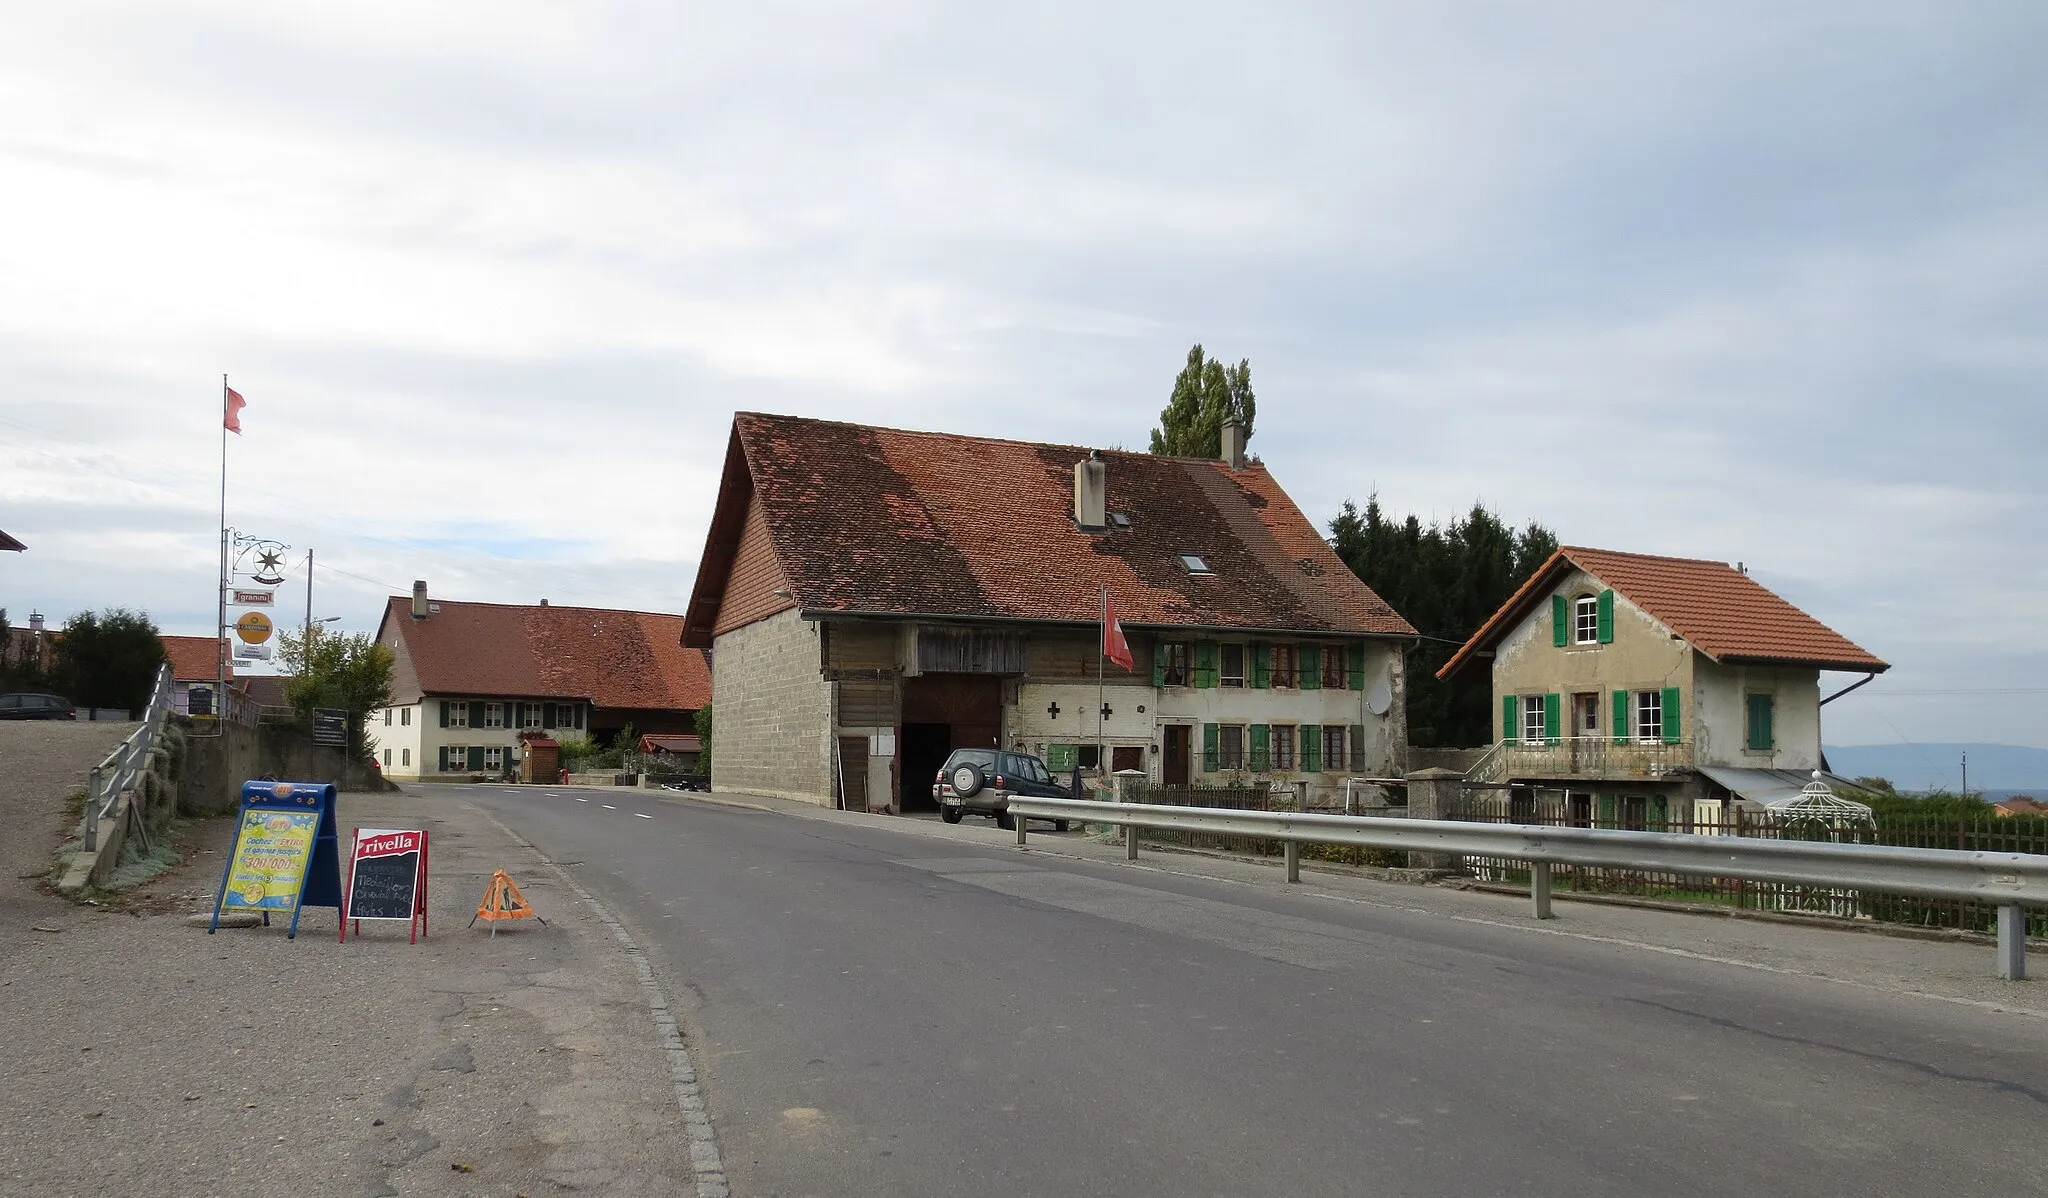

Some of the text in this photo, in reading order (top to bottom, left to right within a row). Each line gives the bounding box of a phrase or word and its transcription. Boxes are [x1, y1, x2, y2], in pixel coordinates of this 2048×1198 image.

[240, 594, 267, 603] granini
[365, 835, 413, 853] rivella
[251, 848, 276, 856] gagnez
